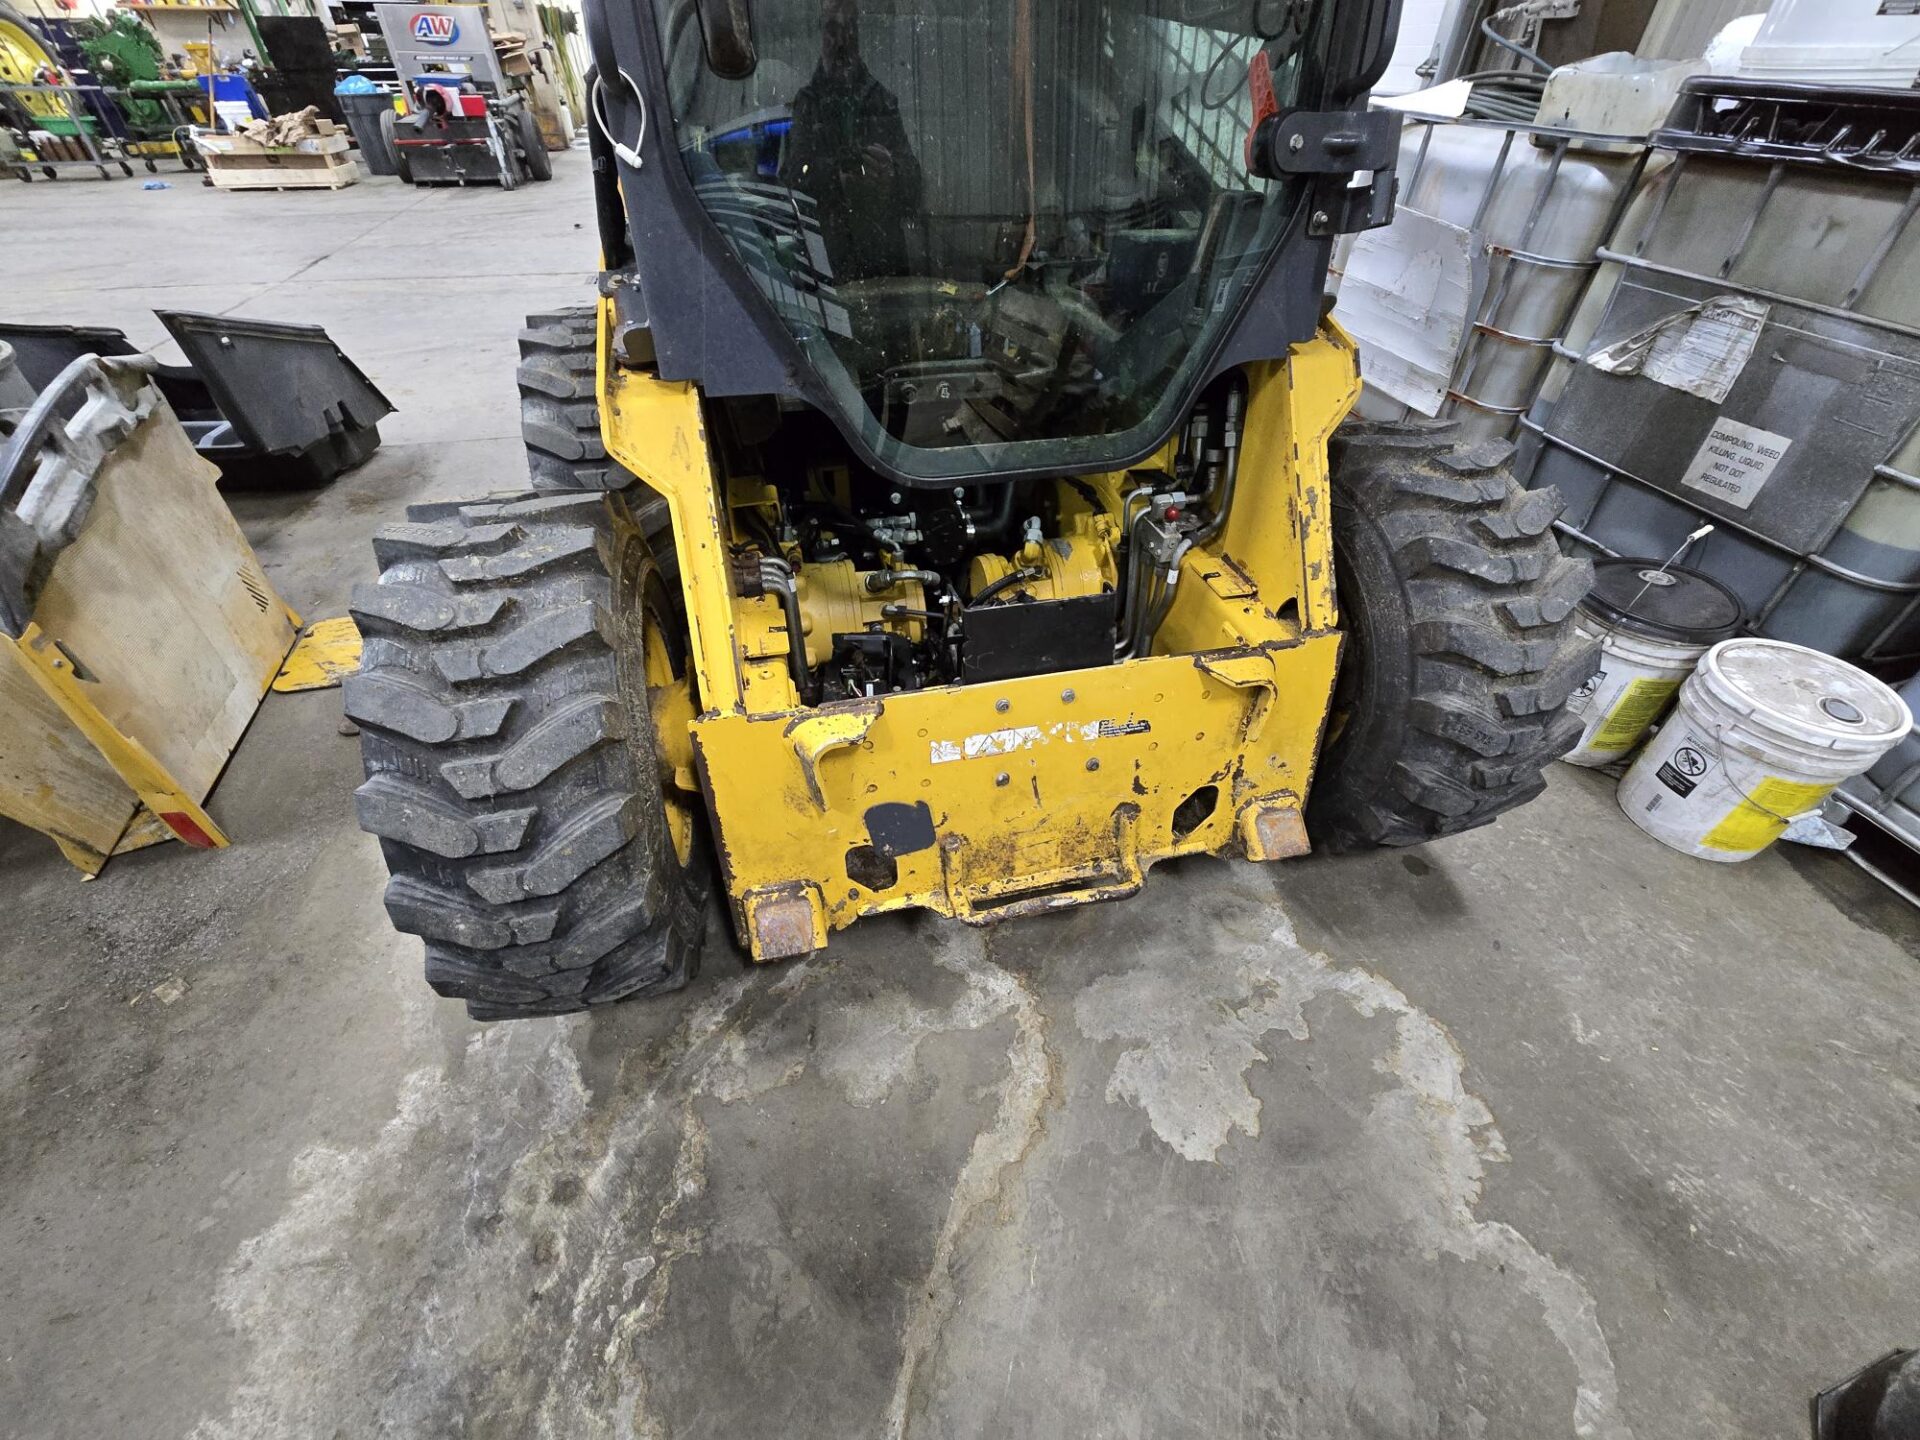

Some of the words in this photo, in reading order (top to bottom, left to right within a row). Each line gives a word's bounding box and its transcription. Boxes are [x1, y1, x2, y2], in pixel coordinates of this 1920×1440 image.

[416, 16, 453, 36] AW
[1709, 446, 1736, 461] KILLING,
[1711, 431, 1754, 452] COMPOUND,
[1757, 445, 1780, 460] WEED
[1713, 462, 1728, 473] NOT
[1729, 468, 1746, 478] DOT
[1701, 473, 1741, 493] REGULATED
